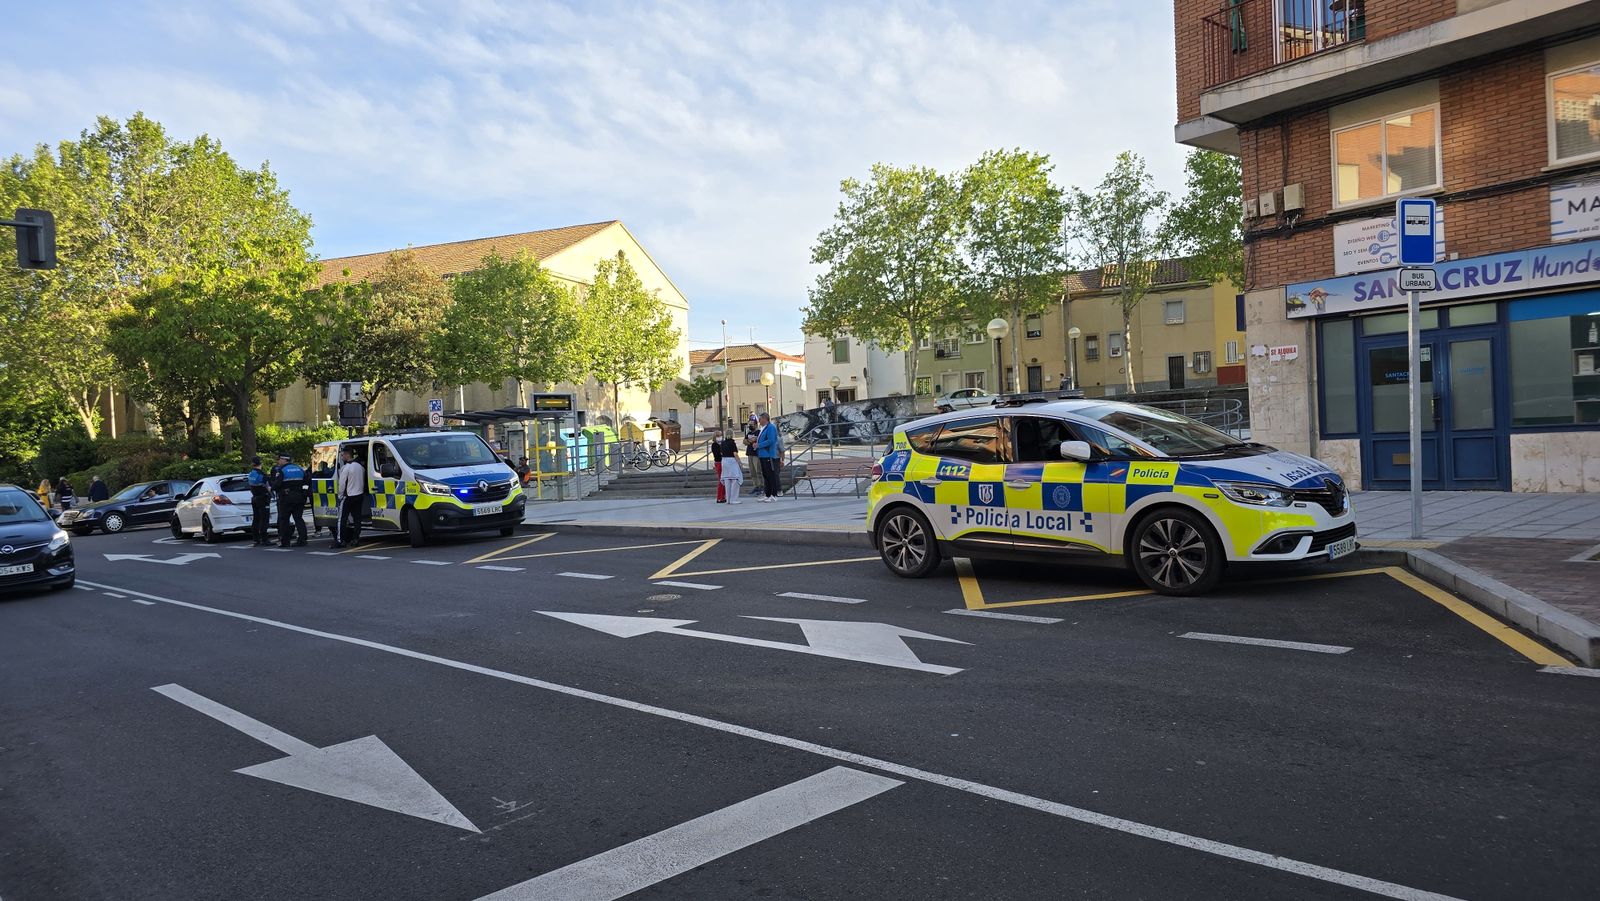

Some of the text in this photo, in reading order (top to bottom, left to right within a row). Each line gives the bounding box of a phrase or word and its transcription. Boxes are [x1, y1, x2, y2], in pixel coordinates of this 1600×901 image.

[1361, 222, 1390, 231] MARKETING
[1353, 259, 1522, 302] SANCRUZ
[944, 465, 966, 476] 112
[1133, 468, 1169, 478] Policía
[966, 507, 1072, 531] Policía Local
